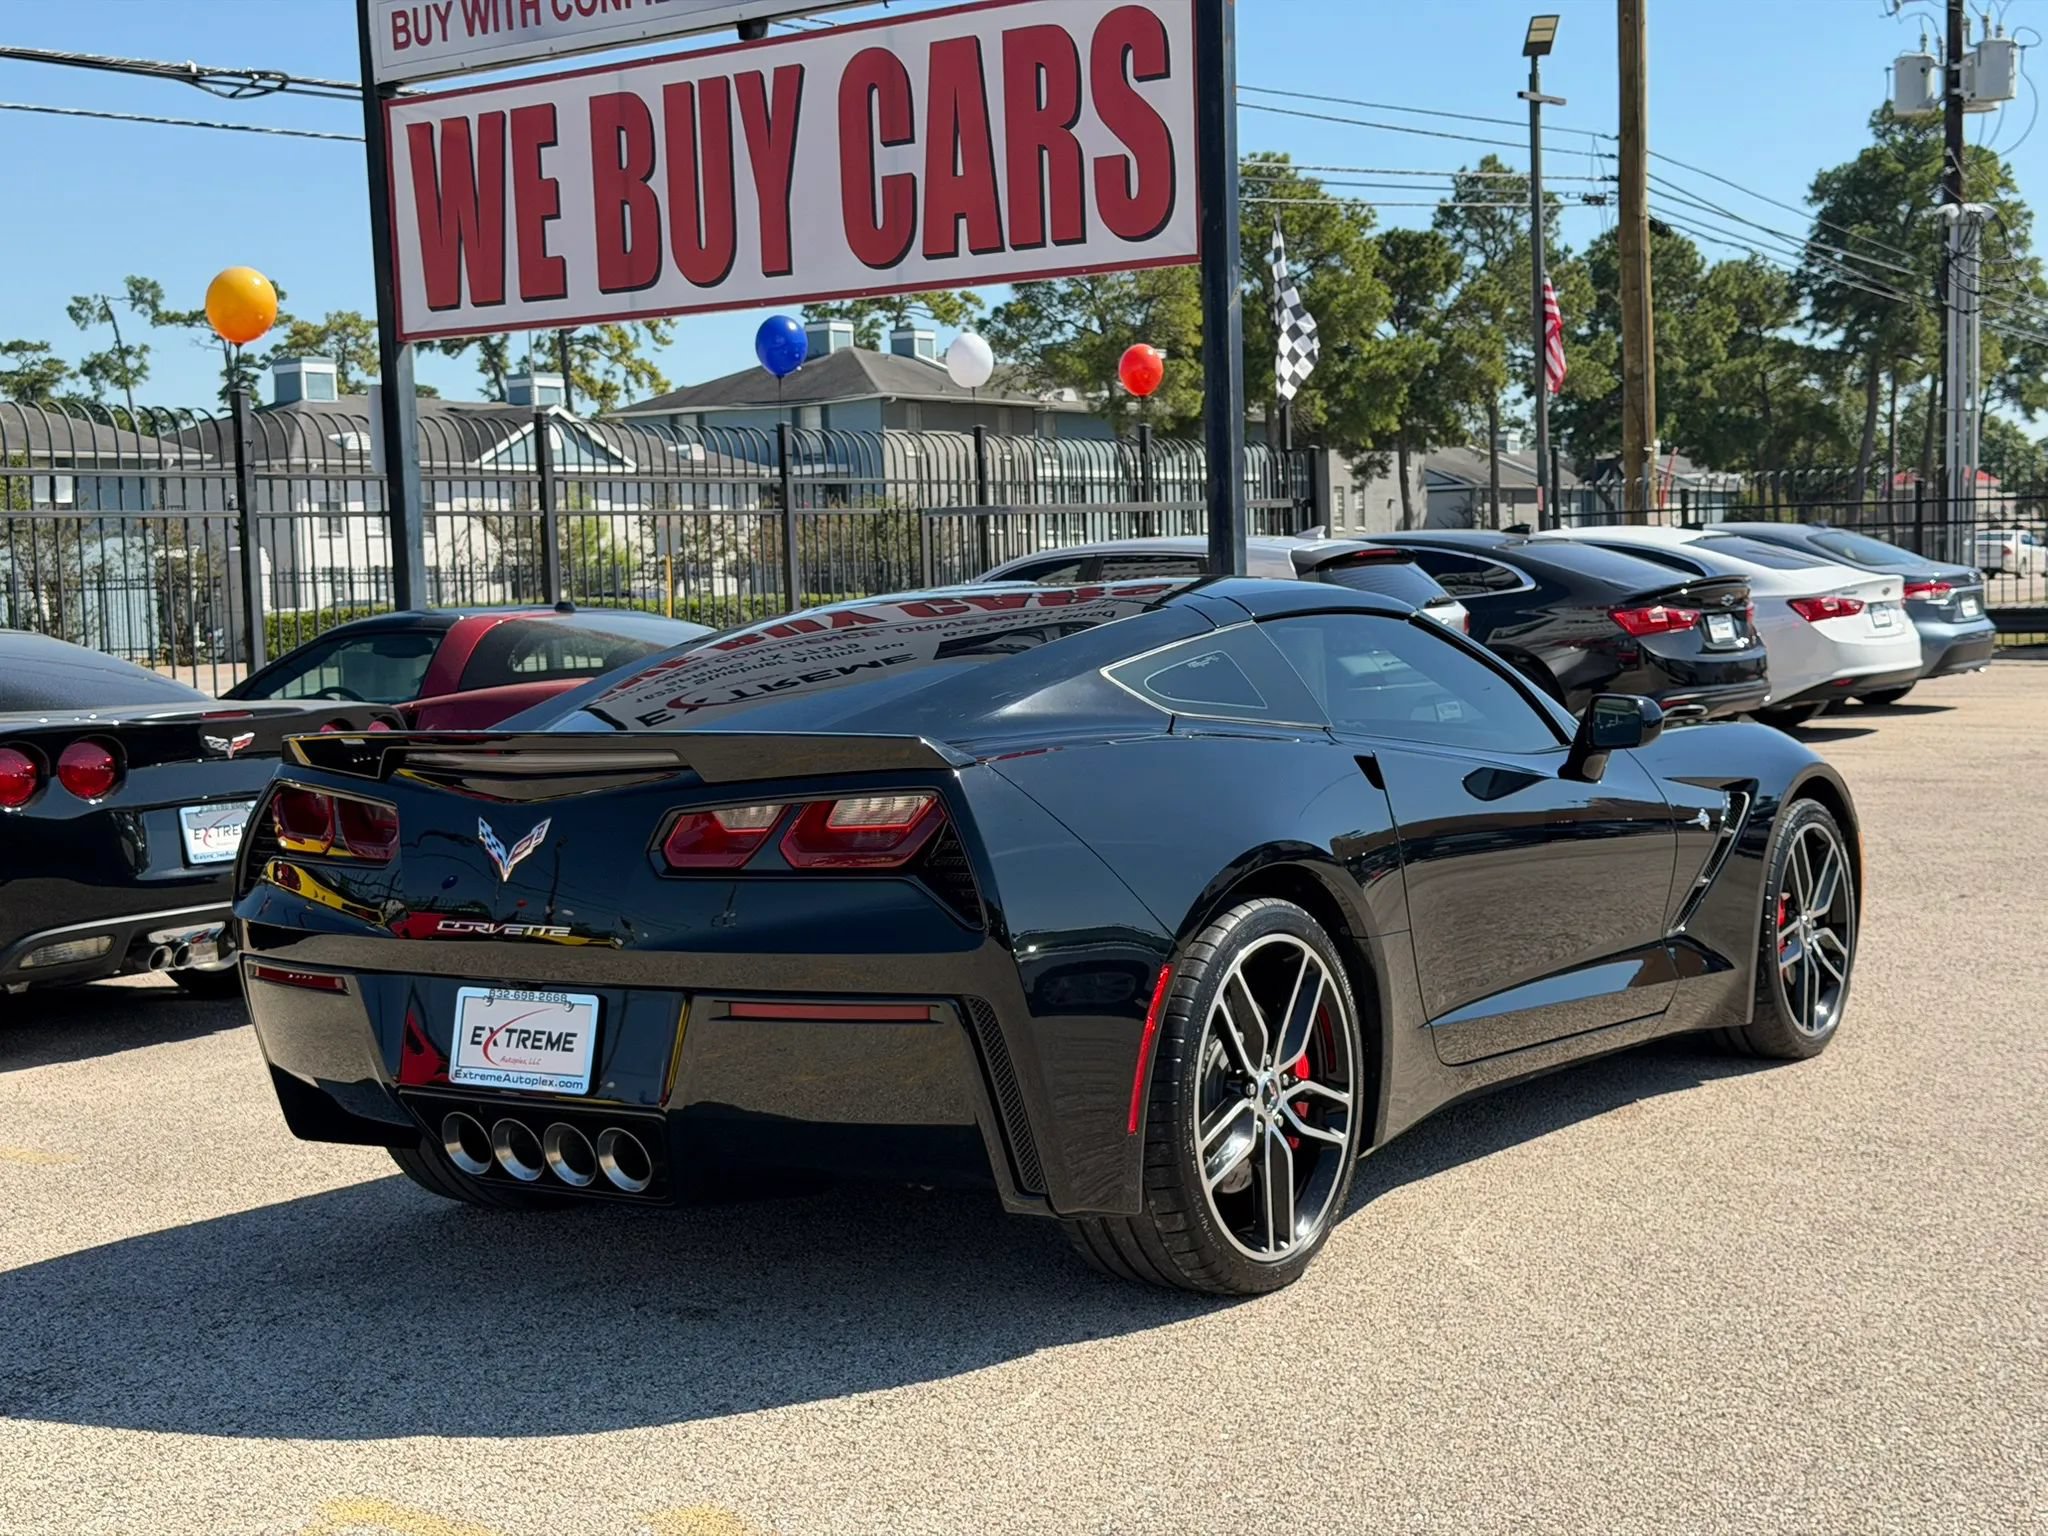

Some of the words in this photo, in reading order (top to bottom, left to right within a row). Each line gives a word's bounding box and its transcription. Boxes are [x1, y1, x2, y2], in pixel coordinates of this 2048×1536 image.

[391, 1, 452, 51] BUY
[461, 0, 541, 38] WITH
[407, 104, 568, 311] WE
[590, 64, 804, 294] BUY
[838, 5, 1178, 270] CARS
[437, 920, 571, 937] CORVETTE
[471, 1026, 577, 1052] EXTREME
[455, 1069, 583, 1089] ExtremeAutoplex.com
